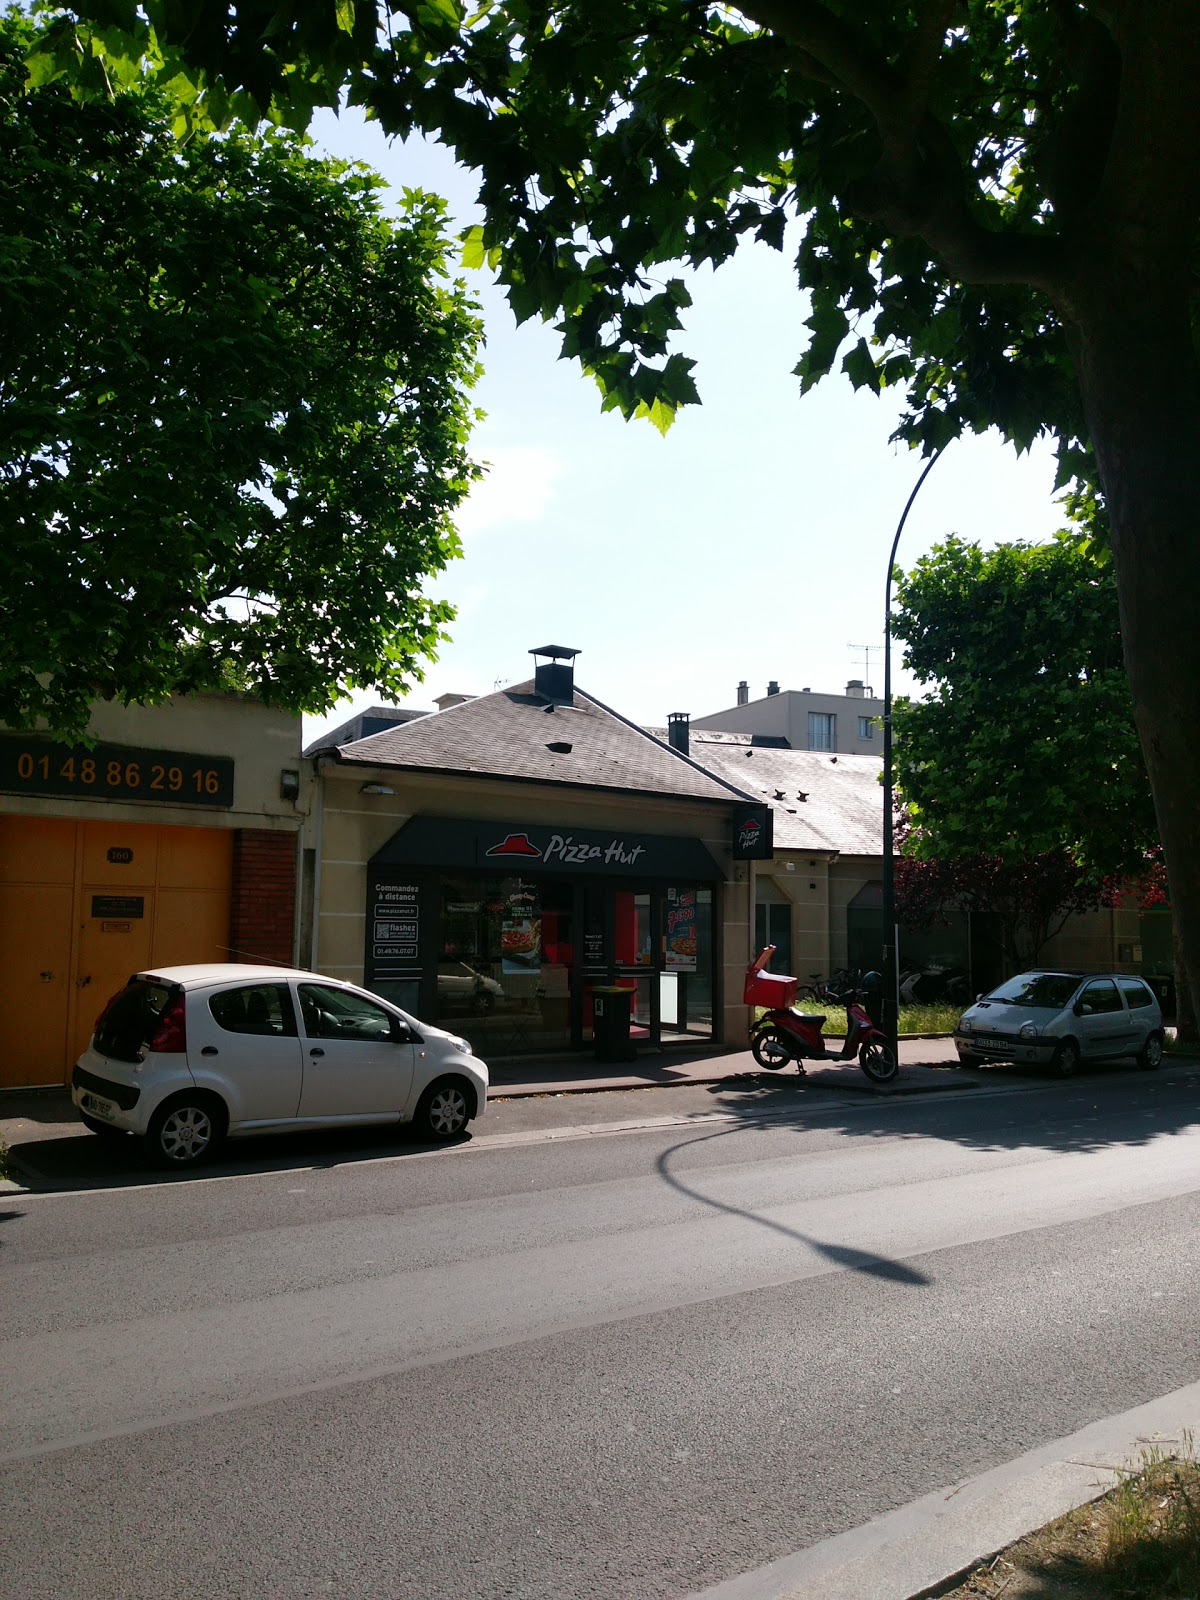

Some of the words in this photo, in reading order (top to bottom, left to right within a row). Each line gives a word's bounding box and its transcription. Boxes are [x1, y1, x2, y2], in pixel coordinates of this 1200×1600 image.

[17, 752, 49, 780] 01
[59, 757, 96, 784] 48
[106, 760, 141, 788] 86
[150, 765, 183, 791] 29
[192, 769, 219, 795] 16
[738, 830, 760, 843] Pizza
[742, 837, 759, 850] Hut
[542, 834, 602, 863] Pizza
[604, 839, 647, 865] Hut
[112, 851, 129, 860] 160
[375, 883, 419, 892] Commandez
[378, 892, 384, 900] à
[385, 892, 416, 901] distance
[390, 924, 416, 932] flashez
